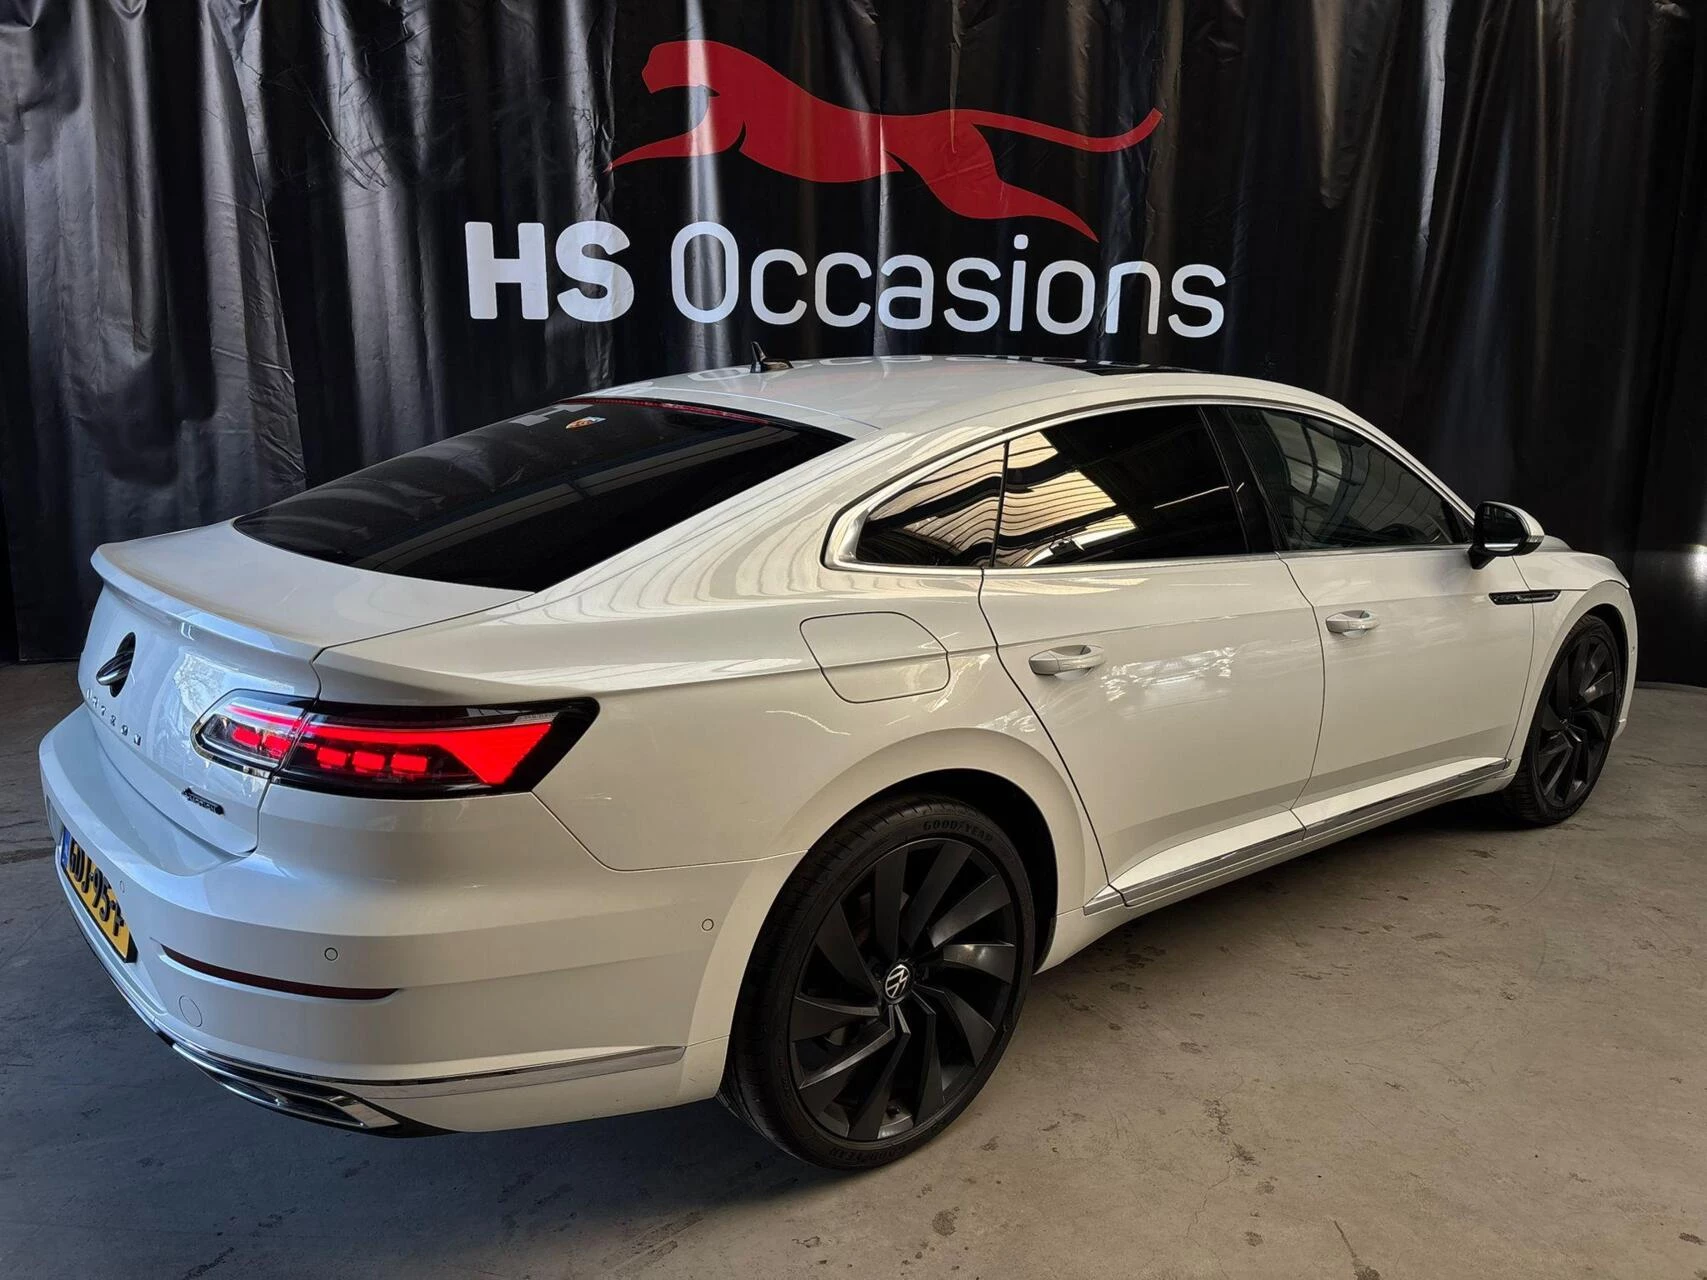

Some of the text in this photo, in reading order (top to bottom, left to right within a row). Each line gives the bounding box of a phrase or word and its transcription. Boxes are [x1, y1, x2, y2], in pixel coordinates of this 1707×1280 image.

[464, 220, 1226, 339] HS Occasions
[923, 819, 994, 841] GOODYEAR
